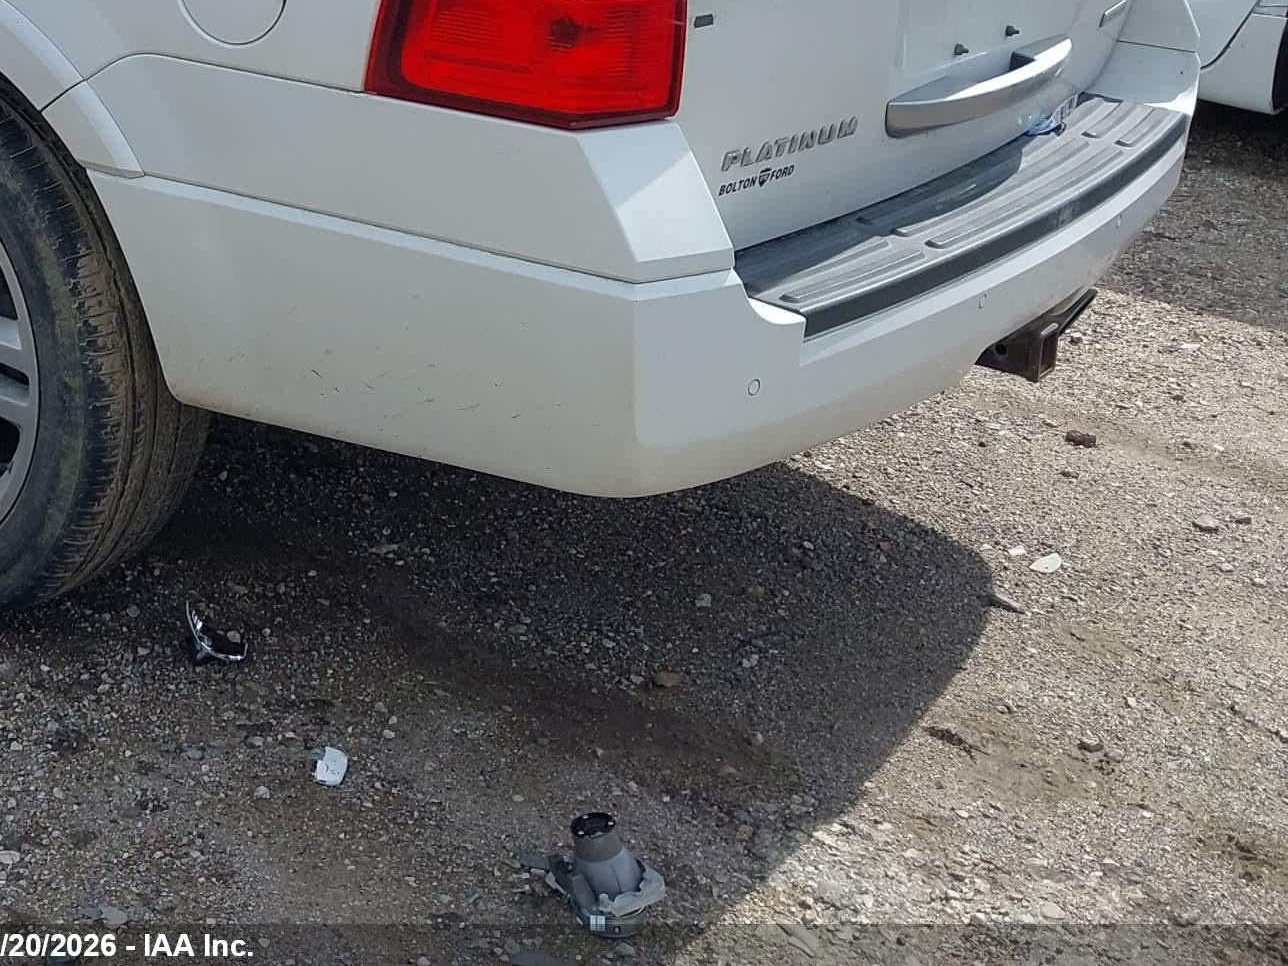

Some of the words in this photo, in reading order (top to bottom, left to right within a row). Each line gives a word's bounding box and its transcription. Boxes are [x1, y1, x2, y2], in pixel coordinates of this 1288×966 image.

[720, 115, 859, 172] PLATINUM
[718, 175, 758, 197] BOLTON
[769, 164, 795, 182] FORD
